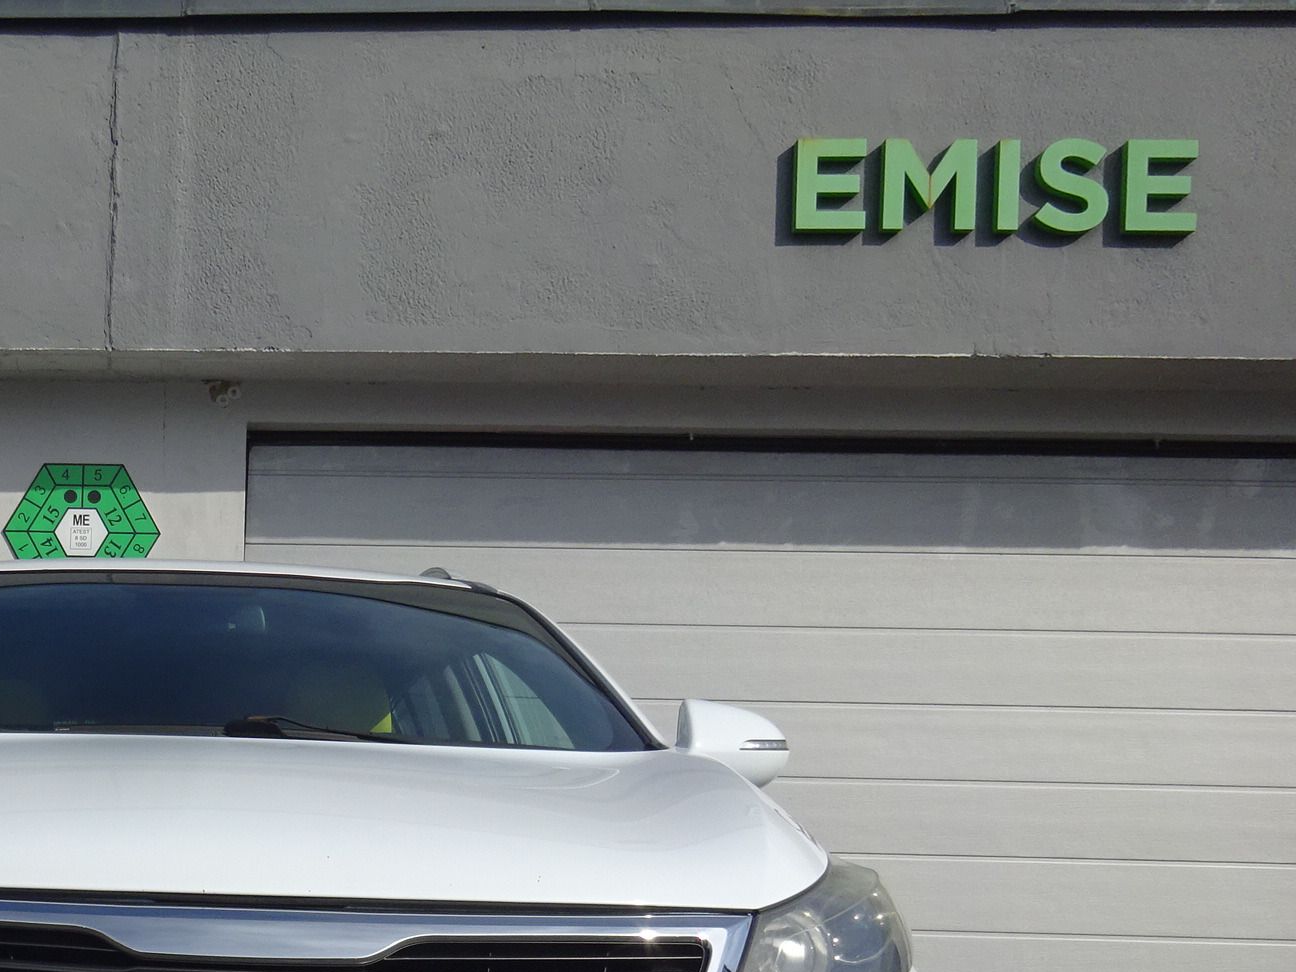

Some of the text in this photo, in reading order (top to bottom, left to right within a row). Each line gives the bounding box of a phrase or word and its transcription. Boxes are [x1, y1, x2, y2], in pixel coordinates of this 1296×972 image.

[792, 137, 1200, 234] EMISE
[61, 468, 70, 481] 4
[94, 469, 103, 481] 5
[34, 485, 46, 496] 3
[17, 512, 30, 523] 2
[42, 505, 60, 525] 15
[72, 513, 90, 526] ME
[104, 507, 122, 526] 12
[134, 512, 147, 521] 7
[18, 543, 29, 552] 1
[40, 536, 59, 557] 14
[104, 539, 122, 558] 13
[133, 543, 145, 554] 8
